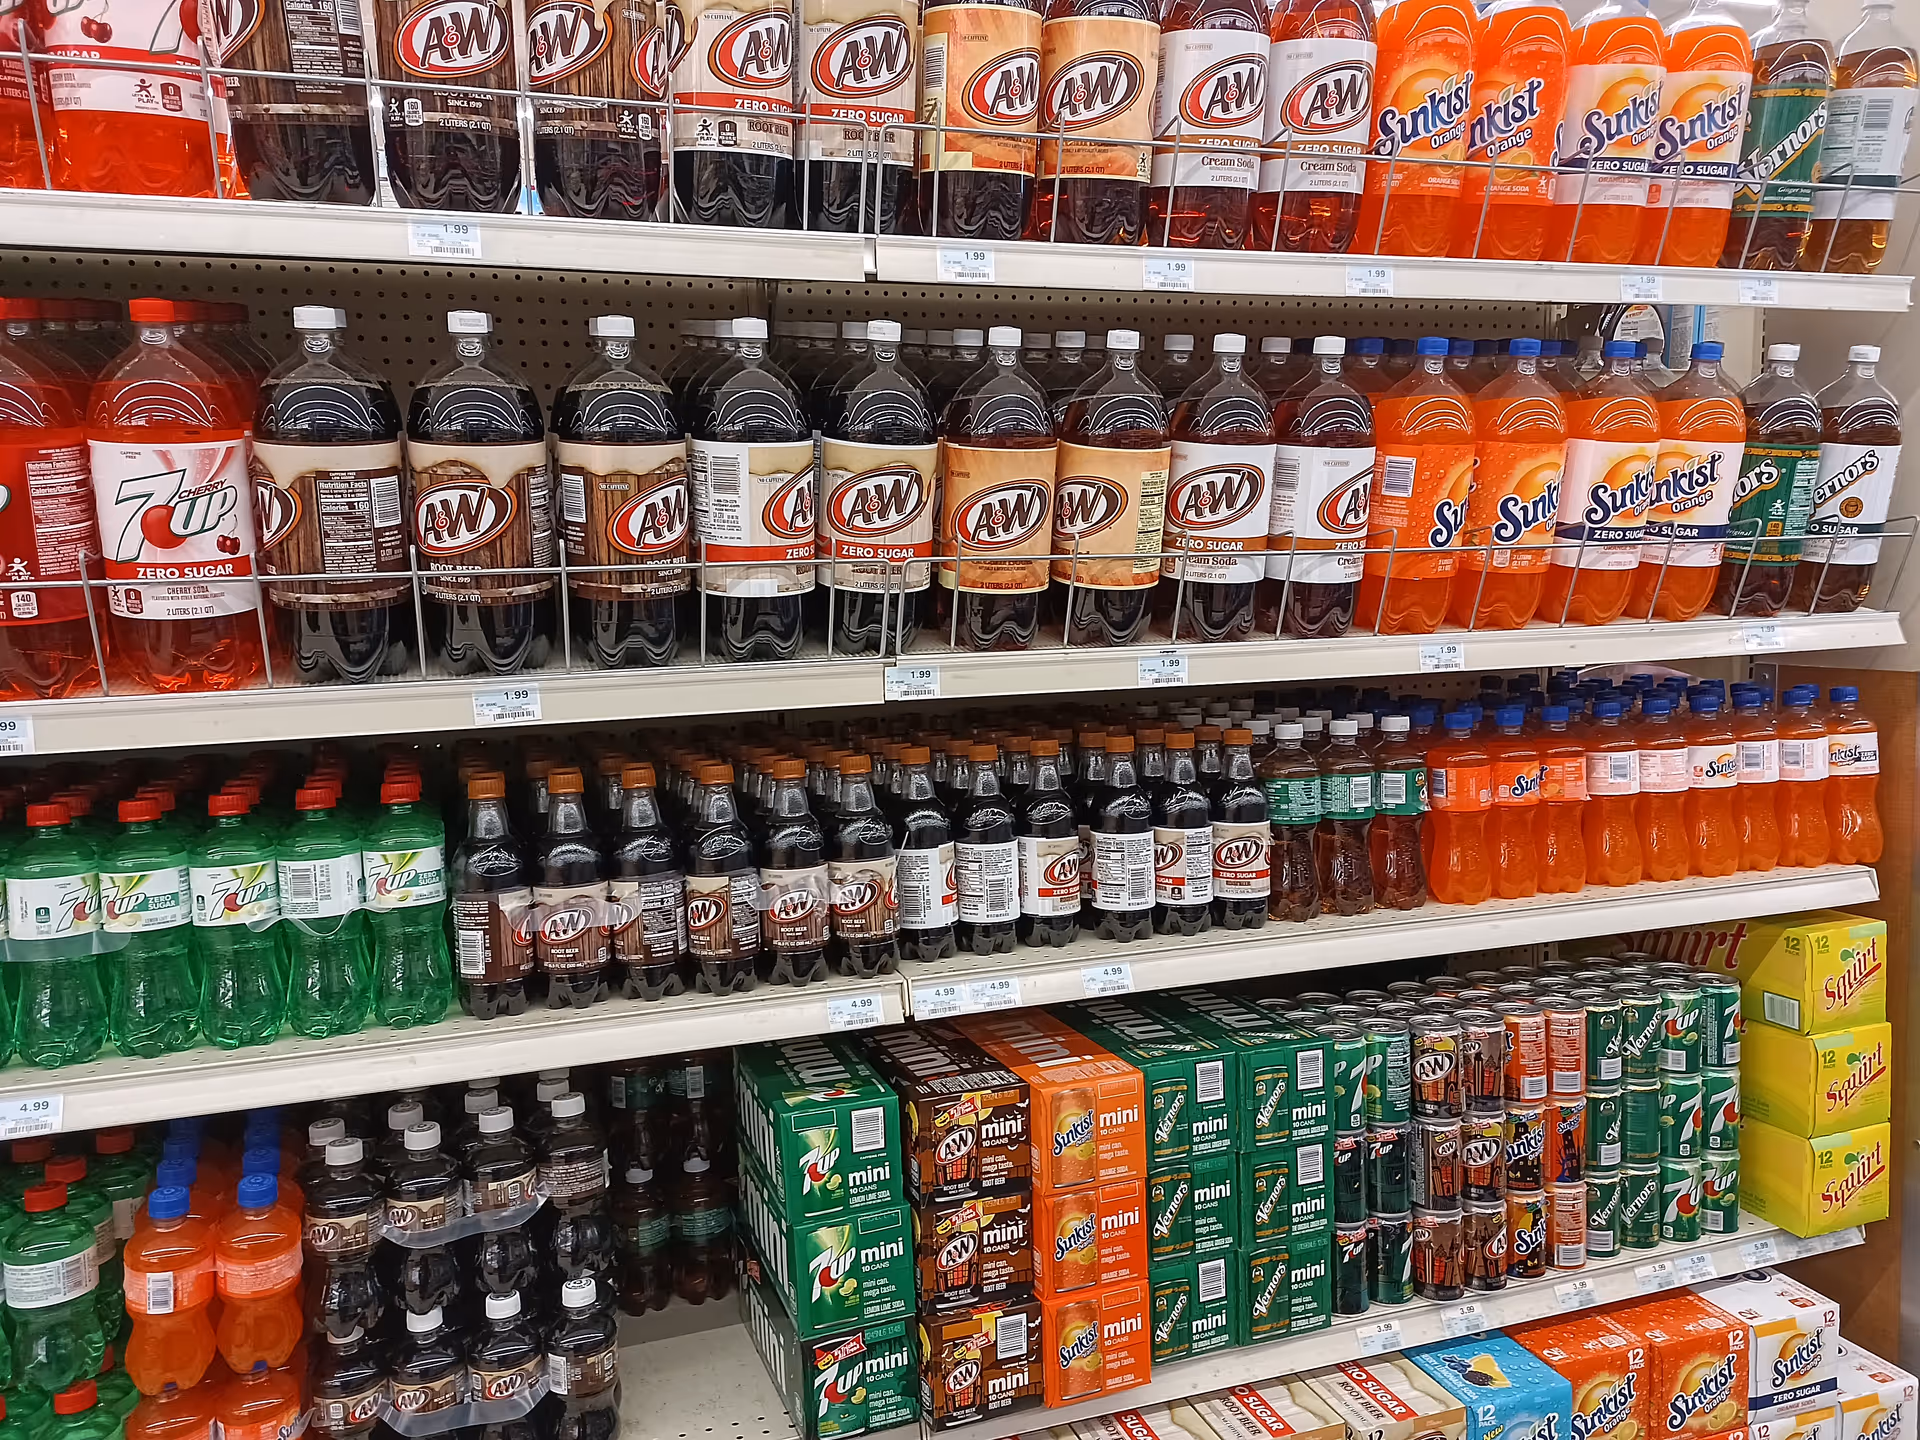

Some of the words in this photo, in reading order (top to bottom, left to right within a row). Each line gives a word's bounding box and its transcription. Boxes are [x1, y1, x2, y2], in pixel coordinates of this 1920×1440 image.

[317, 1, 333, 10] 160
[420, 3, 497, 68] A&W
[833, 25, 904, 89] A&W
[1057, 61, 1124, 118] A&W
[1205, 64, 1264, 119] A&W
[1304, 70, 1367, 126] A&W
[831, 109, 866, 121] ZERO
[869, 111, 904, 123] SUGAR
[1374, 70, 1474, 157] Sunkist
[1579, 81, 1663, 157] Sunkist
[444, 119, 468, 128] LITERS
[1654, 84, 1745, 161] Sunkist
[1431, 122, 1466, 149] Orange
[1707, 126, 1739, 151] Orange
[1737, 101, 1828, 196] Vernors
[1201, 156, 1234, 167] Cream
[1236, 157, 1254, 169] Soda
[1300, 161, 1335, 172] Cream
[1336, 162, 1357, 173] Soda
[1590, 161, 1620, 172] ZERO
[1662, 164, 1695, 175] ZERO
[1697, 165, 1729, 176] SUGAR
[442, 223, 469, 235] 1.99
[964, 252, 986, 262] 1.99
[1167, 262, 1187, 272] 1.99
[1367, 269, 1386, 278] 1.99
[1640, 276, 1656, 284] 1.99
[1757, 279, 1772, 287] 1.99
[178, 479, 227, 500] CHERRY
[846, 474, 916, 527] A&W
[1180, 472, 1248, 522] A&W
[1672, 490, 1713, 513] Orange
[353, 501, 369, 510] 160
[424, 488, 488, 546] A&W
[971, 488, 1037, 542] A&W
[1594, 529, 1616, 539] ZERO
[841, 545, 874, 557] ZERO
[877, 546, 914, 558] SUGAR
[1206, 541, 1243, 550] SUGAR
[786, 548, 809, 559] ZERO
[1211, 556, 1238, 565] Soda
[136, 567, 179, 579] ZERO
[183, 564, 234, 579] SUGAR
[1190, 571, 1207, 579] LITERS
[15, 593, 32, 603] 140
[167, 587, 189, 595] CHERRY
[439, 593, 456, 601] LITERS
[171, 607, 188, 615] LITERS
[1440, 646, 1456, 654] 1.99
[1161, 659, 1180, 667] 1.99
[910, 669, 931, 679] 1.99
[503, 690, 529, 700] 1.99
[418, 877, 440, 885] SUGAR
[148, 895, 171, 904] ZERO
[148, 900, 176, 910] SUGAR
[1784, 936, 1800, 951] 12
[1815, 935, 1829, 949] 12
[1103, 967, 1122, 976] 4.99
[1824, 937, 1878, 1012] Squirt
[935, 987, 955, 997] 4.99
[990, 981, 1010, 990] 4.99
[851, 999, 873, 1008] 4.99
[1822, 1050, 1835, 1064] 12
[1827, 1041, 1882, 1112] Squirt
[20, 1100, 49, 1112] 4.99
[1255, 1080, 1286, 1128] Vernors
[1292, 1100, 1327, 1121] mini
[1100, 1105, 1138, 1127] mini
[1154, 1092, 1185, 1144] Vernors
[981, 1118, 1023, 1140] mini
[1108, 1126, 1125, 1134] CANS
[1192, 1114, 1228, 1136] mini
[1053, 1110, 1094, 1156] Sunkist
[991, 1138, 1008, 1146] CANS
[1369, 1143, 1393, 1159] 7UP
[1818, 1151, 1833, 1164] 12
[799, 1147, 840, 1196] 7UP
[982, 1164, 998, 1173] mega
[999, 1161, 1014, 1170] taste.
[848, 1162, 890, 1187] mini
[994, 1177, 1005, 1186] BEER
[1821, 1141, 1881, 1213] Squirt
[858, 1184, 877, 1193] CANS
[1194, 1180, 1230, 1203] mini
[1255, 1176, 1286, 1225] Vernors
[1292, 1194, 1325, 1216] mini
[1153, 1181, 1189, 1239] Vernors
[1101, 1207, 1139, 1231] mini
[983, 1224, 1024, 1245] mini
[1055, 1213, 1096, 1261] Sunkist
[1110, 1229, 1127, 1237] CANS
[860, 1238, 904, 1264] mini
[992, 1243, 1010, 1252] CANS
[1754, 1242, 1768, 1250] 5.99
[1343, 1243, 1364, 1264] 7UP
[1690, 1256, 1704, 1264] 5.99
[871, 1261, 890, 1271] CANS
[1291, 1260, 1325, 1283] mini
[1652, 1264, 1666, 1272] 3.99
[809, 1247, 856, 1304] 7UP
[876, 1277, 889, 1286] can.
[863, 1288, 880, 1298] mega
[880, 1284, 897, 1294] taste.
[1253, 1262, 1287, 1318] Vernors
[1573, 1282, 1587, 1290] 3.99
[864, 1306, 880, 1315] LEMON
[880, 1303, 892, 1312] LIME
[1460, 1306, 1474, 1315] 3.99
[1155, 1293, 1188, 1344] Vernors
[1192, 1310, 1227, 1334] mini
[1823, 1310, 1835, 1323] 12
[1103, 1313, 1142, 1338] mini
[1377, 1323, 1392, 1332] 3.99
[1059, 1322, 1098, 1369] Sunkist
[1728, 1330, 1744, 1347] 12
[865, 1347, 908, 1374] mini
[1628, 1348, 1644, 1366] 12
[1771, 1328, 1823, 1389] Sunkist
[1629, 1362, 1645, 1370] PACK
[1800, 1355, 1821, 1375] Orange
[875, 1371, 893, 1381] CANS
[988, 1369, 1029, 1394] mini
[814, 1362, 863, 1419] 7UP
[997, 1390, 1015, 1399] CANS
[1364, 1379, 1406, 1415] SUGAR
[1667, 1354, 1736, 1431] Sunkist
[1773, 1391, 1794, 1404] ZERO
[1796, 1384, 1821, 1398] SUGAR
[1903, 1385, 1914, 1397] 12
[869, 1399, 886, 1409] mega
[1338, 1380, 1362, 1401] ROOT
[1359, 1399, 1385, 1420] BEER
[1572, 1373, 1636, 1440] Sunkist
[1704, 1388, 1730, 1414] Orange
[1776, 1402, 1801, 1412] ORANGE
[1802, 1399, 1815, 1407] SODA
[1244, 1395, 1284, 1431] SUGAR
[1477, 1405, 1496, 1421] 12
[1604, 1407, 1631, 1432] Orange
[1238, 1414, 1262, 1436] BEER
[1479, 1419, 1496, 1427] PACK
[1757, 1425, 1769, 1438] 12
